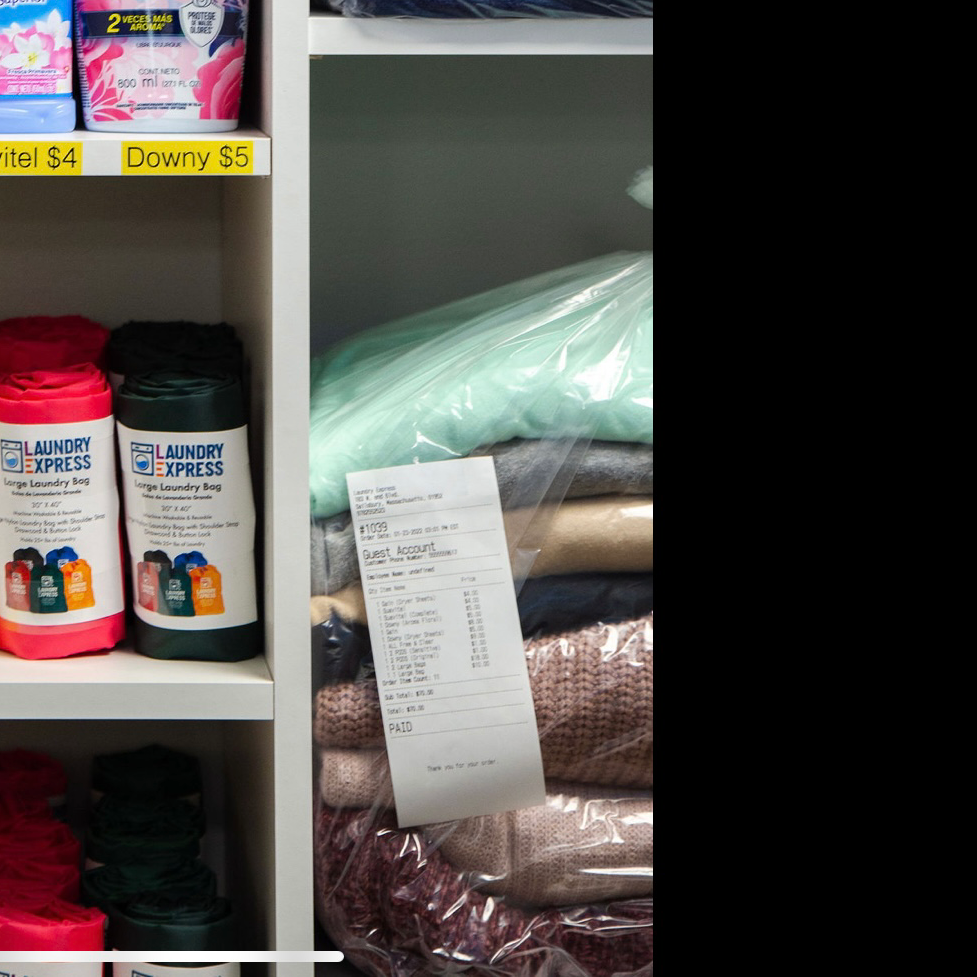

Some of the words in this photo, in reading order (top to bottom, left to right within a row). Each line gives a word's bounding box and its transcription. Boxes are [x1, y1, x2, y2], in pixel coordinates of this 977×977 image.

[107, 13, 121, 33] 2
[122, 15, 150, 23] VECES
[153, 13, 173, 23] MÁS
[188, 12, 216, 20] PROTEGE
[118, 79, 136, 88] 800
[143, 75, 157, 88] ml
[47, 145, 77, 170] $4
[128, 147, 210, 171] Downy
[219, 145, 249, 168] $5
[24, 437, 91, 456] LAUNDRY
[156, 443, 224, 460] LAUNDRY
[25, 455, 91, 473] EXPRESS
[156, 461, 224, 477] EXPRESS
[4, 478, 28, 489] Large
[30, 478, 69, 489] Laundry
[73, 477, 90, 487] Bag
[135, 480, 157, 491] Large
[160, 483, 200, 493] Laundry
[203, 483, 222, 492] Bag
[360, 522, 388, 535] #1039
[363, 547, 391, 560] Guest
[397, 542, 436, 555] Account
[389, 721, 412, 734] PAID
